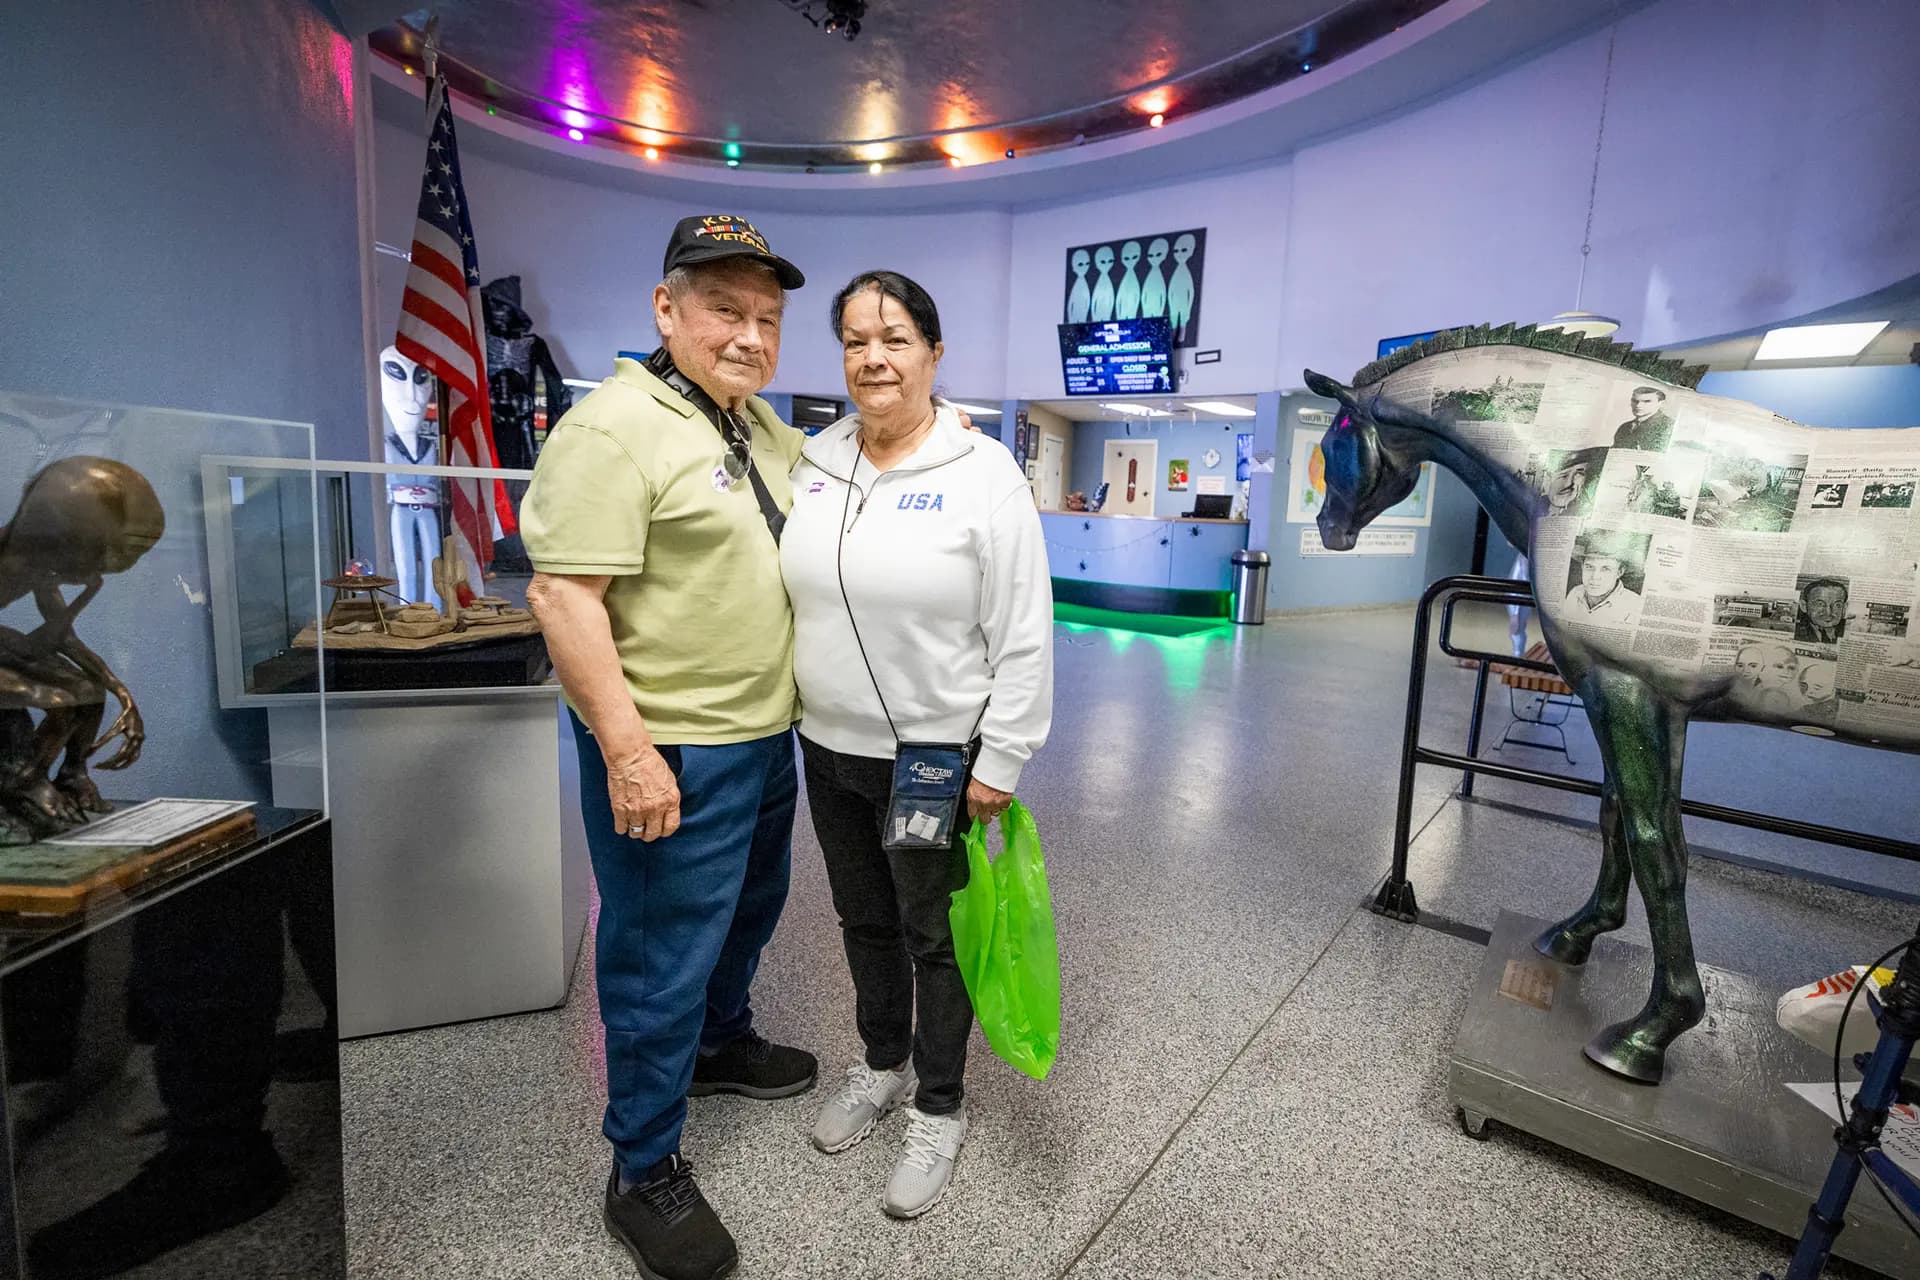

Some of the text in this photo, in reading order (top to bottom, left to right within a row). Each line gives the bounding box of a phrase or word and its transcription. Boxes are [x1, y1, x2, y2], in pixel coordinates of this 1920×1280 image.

[1078, 341, 1151, 353] GENERAL ADMISSION
[1121, 364, 1148, 372] CLOSED
[897, 493, 943, 512] USA
